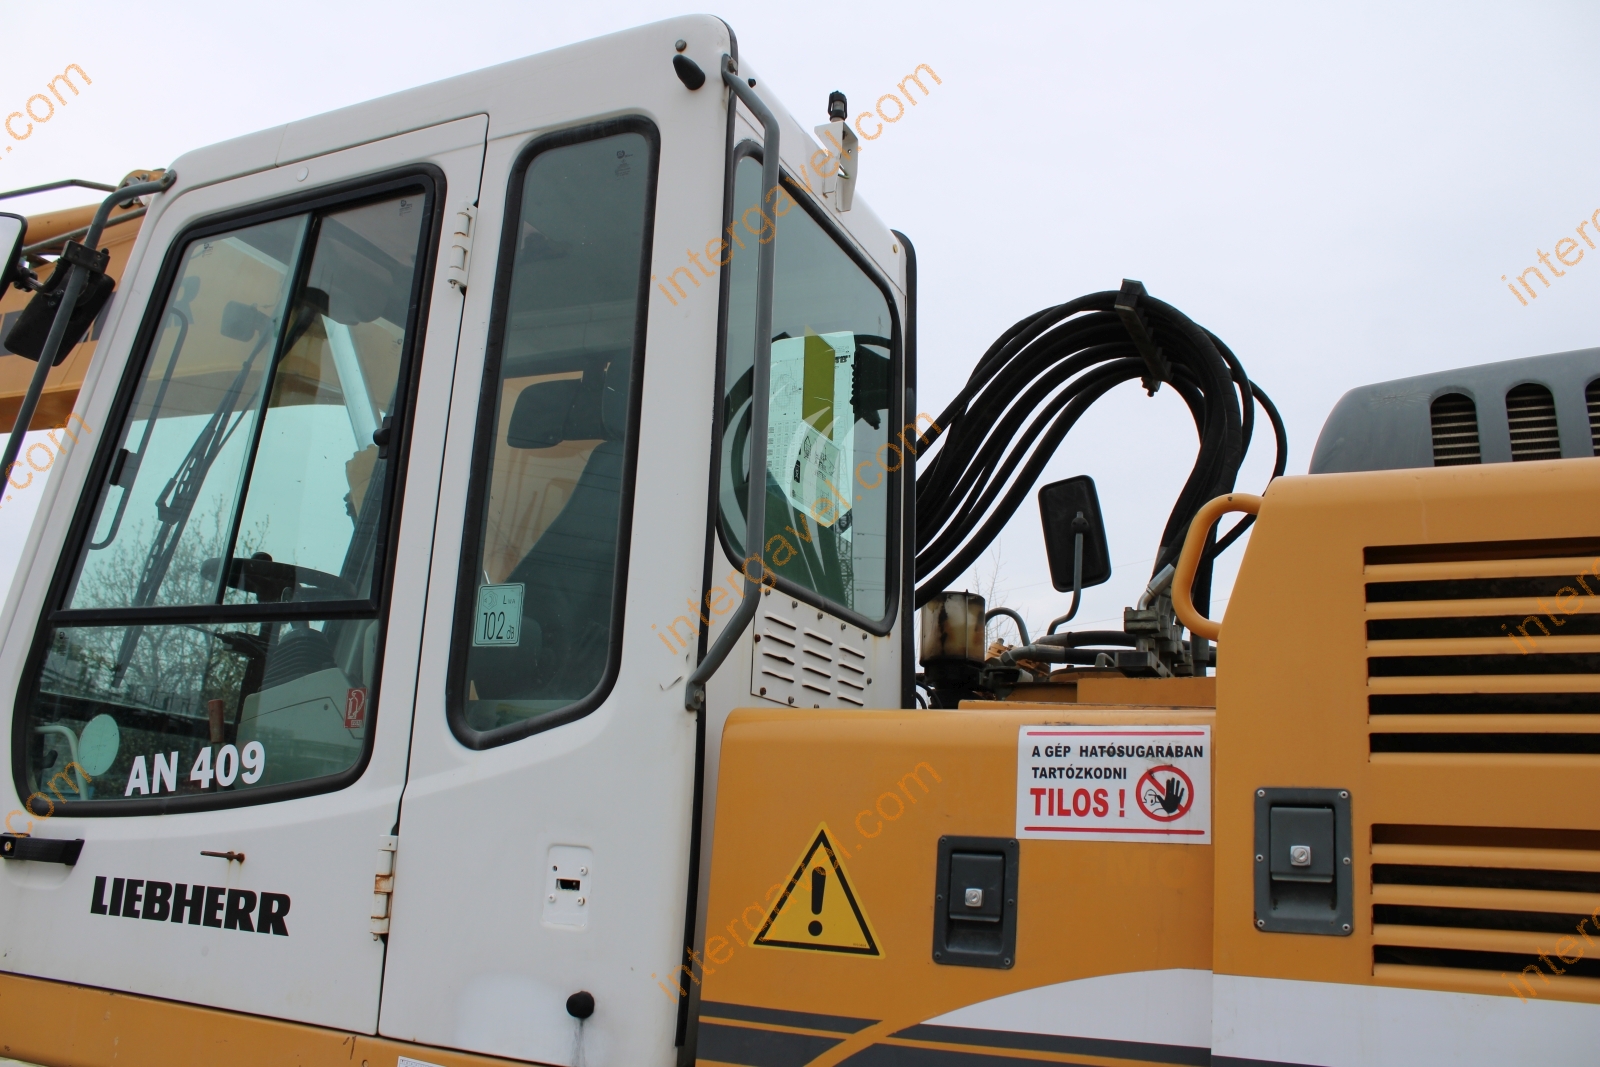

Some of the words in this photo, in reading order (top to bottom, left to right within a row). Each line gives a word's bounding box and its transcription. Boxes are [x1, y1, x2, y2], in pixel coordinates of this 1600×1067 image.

[483, 611, 505, 641] 102
[1032, 745, 1041, 758] A
[1044, 743, 1071, 758] GÉP
[1079, 742, 1204, 758] HATÓSUGARÁBAN
[124, 751, 178, 797] AN
[189, 740, 266, 789] 409
[1031, 764, 1127, 780] TARTÓZKODNI
[1030, 788, 1109, 818] TILOS
[90, 875, 292, 937] LIEBHERR
